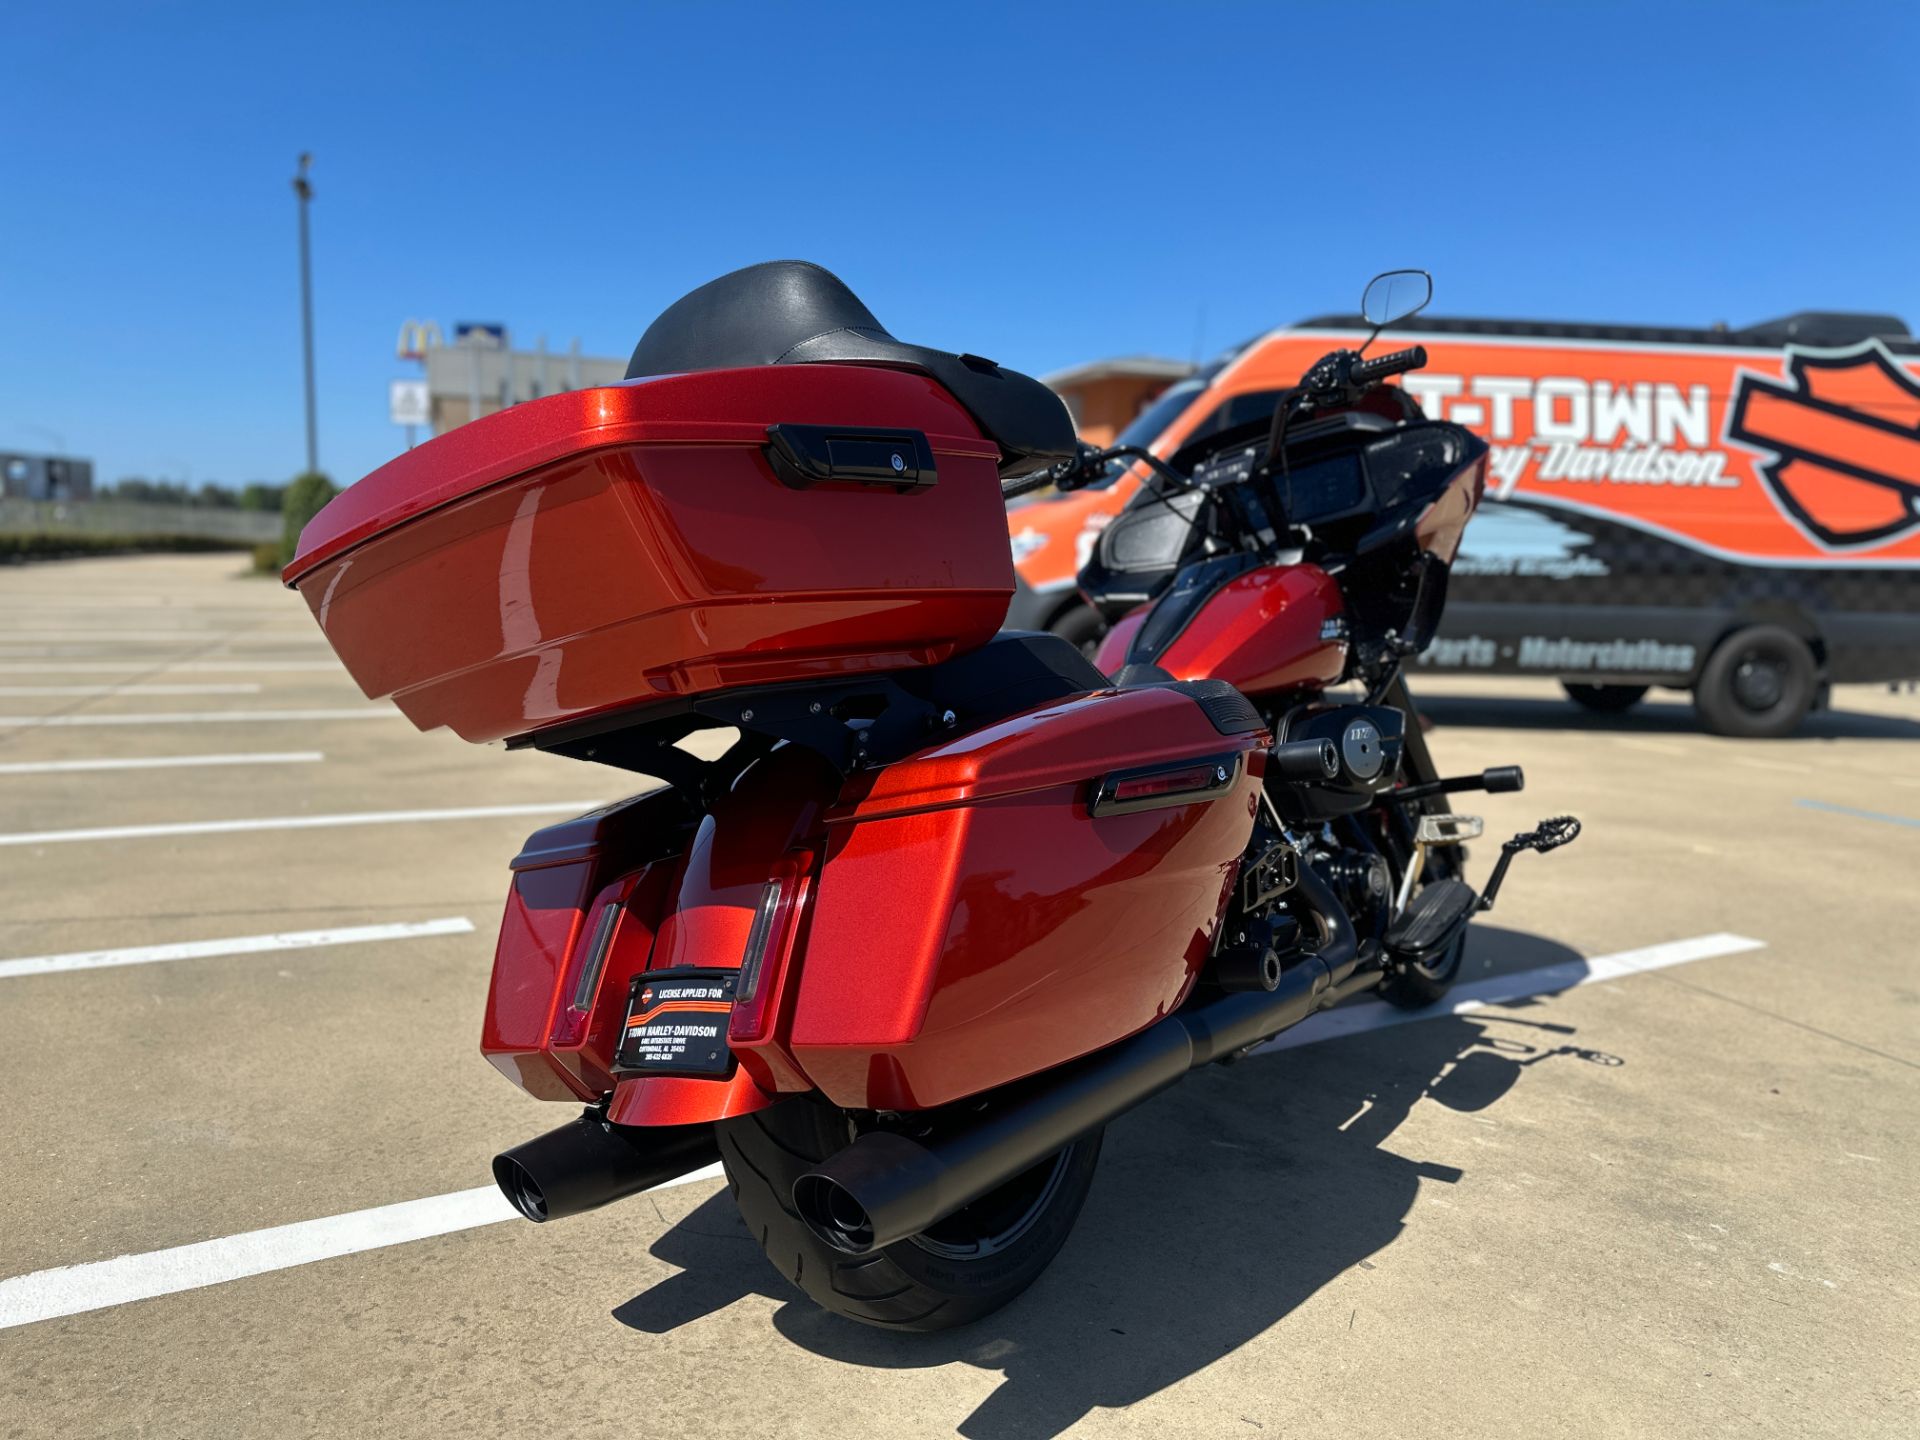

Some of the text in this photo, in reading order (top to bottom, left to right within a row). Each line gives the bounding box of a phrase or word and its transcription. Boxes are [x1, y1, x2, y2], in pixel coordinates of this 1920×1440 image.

[1401, 374, 1710, 447] T-TOWN
[1488, 434, 1741, 500] ey-Davidson
[1417, 635, 1695, 671] Parts Motorclothes
[659, 987, 723, 998] LICENSE APPLIED FOR
[647, 1025, 717, 1038] HARLEY-DAVIDSON
